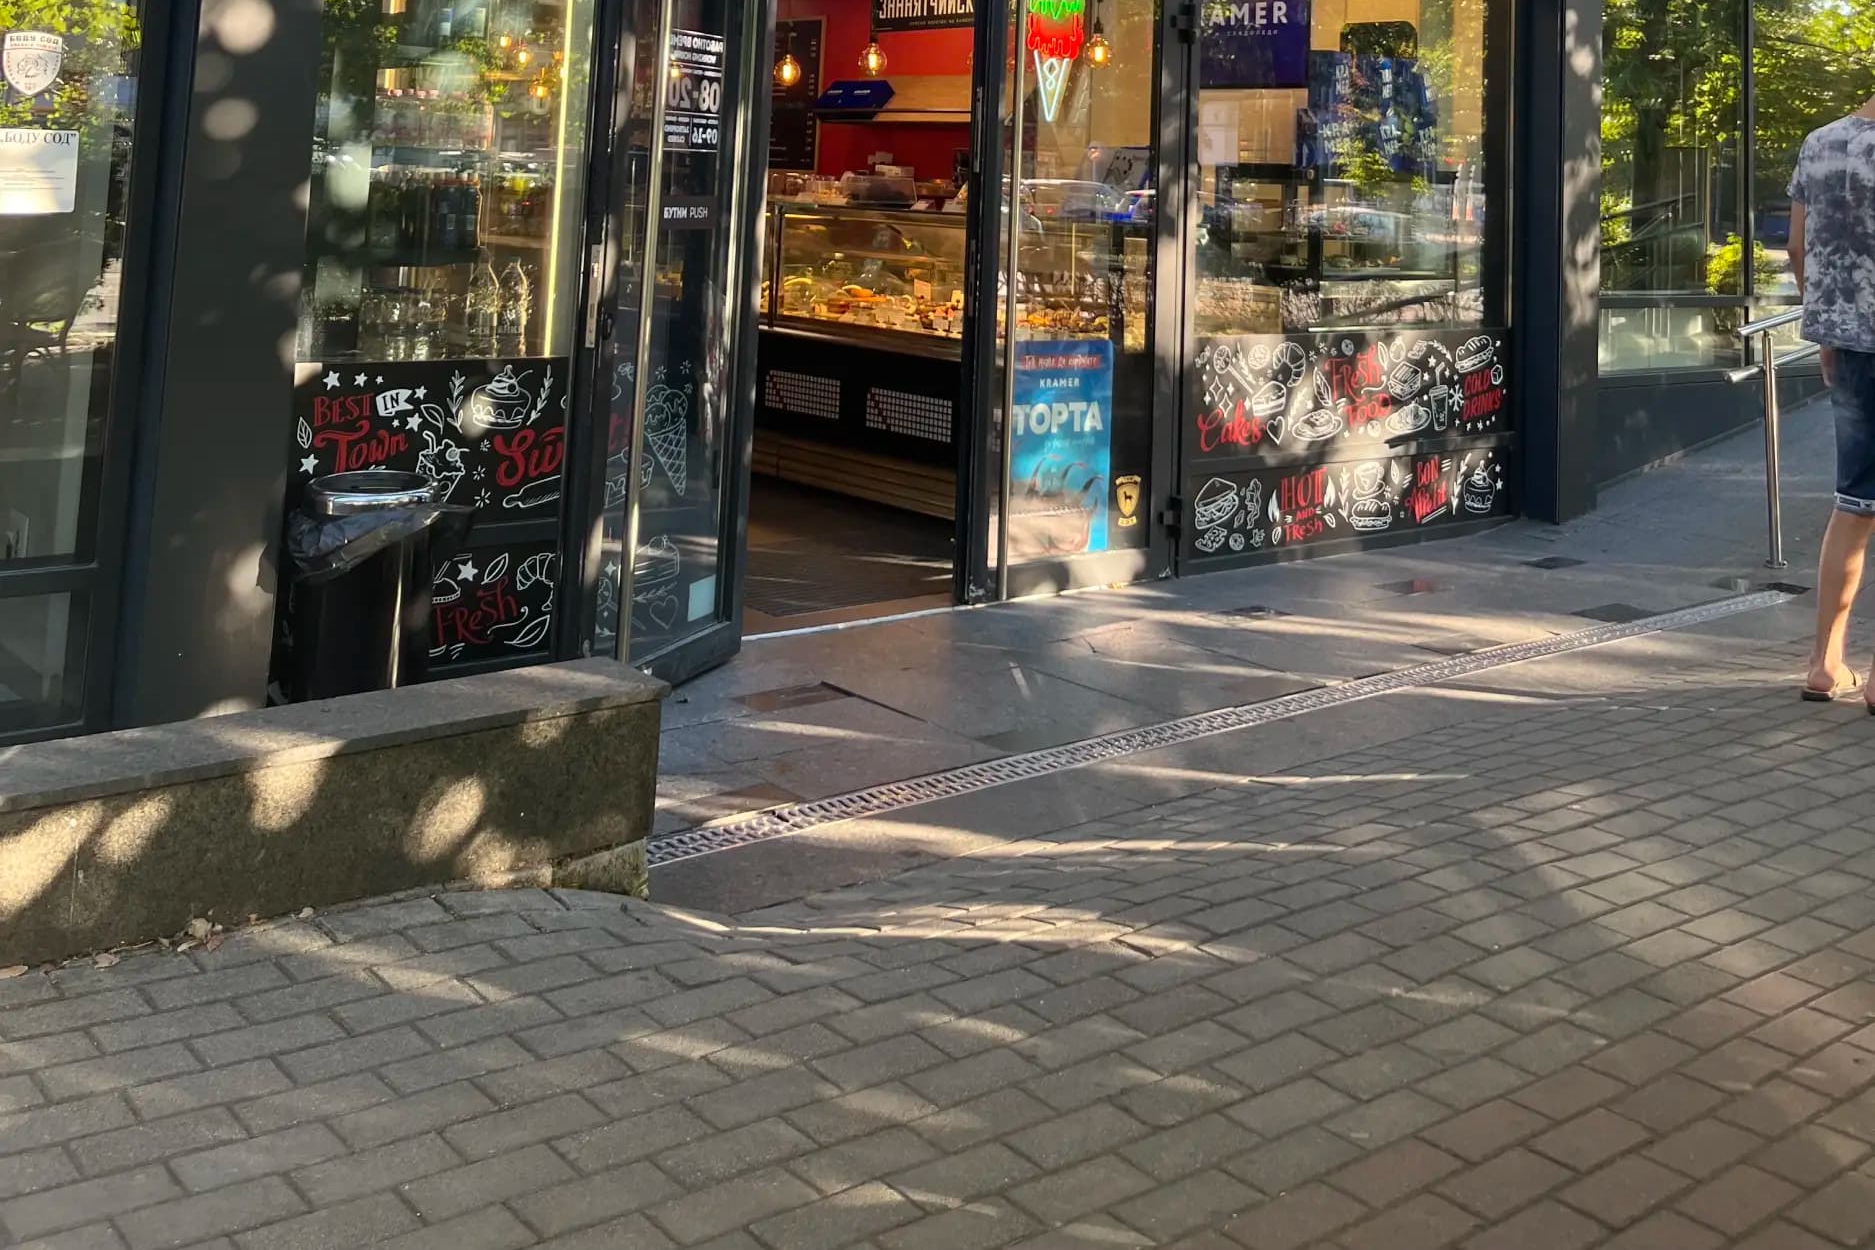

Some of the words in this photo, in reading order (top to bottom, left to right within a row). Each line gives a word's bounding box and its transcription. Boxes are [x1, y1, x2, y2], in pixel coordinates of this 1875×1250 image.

[690, 206, 708, 219] PUSH
[1039, 377, 1080, 389] KRAMER
[1464, 370, 1491, 396] COLD
[314, 393, 374, 427] BEST
[382, 392, 401, 411] IN
[1013, 401, 1104, 435] ТОРТА
[1462, 391, 1503, 421] DRINKS
[1197, 399, 1264, 452] Cakes
[1417, 455, 1439, 486] BON
[1280, 467, 1327, 512] HOT
